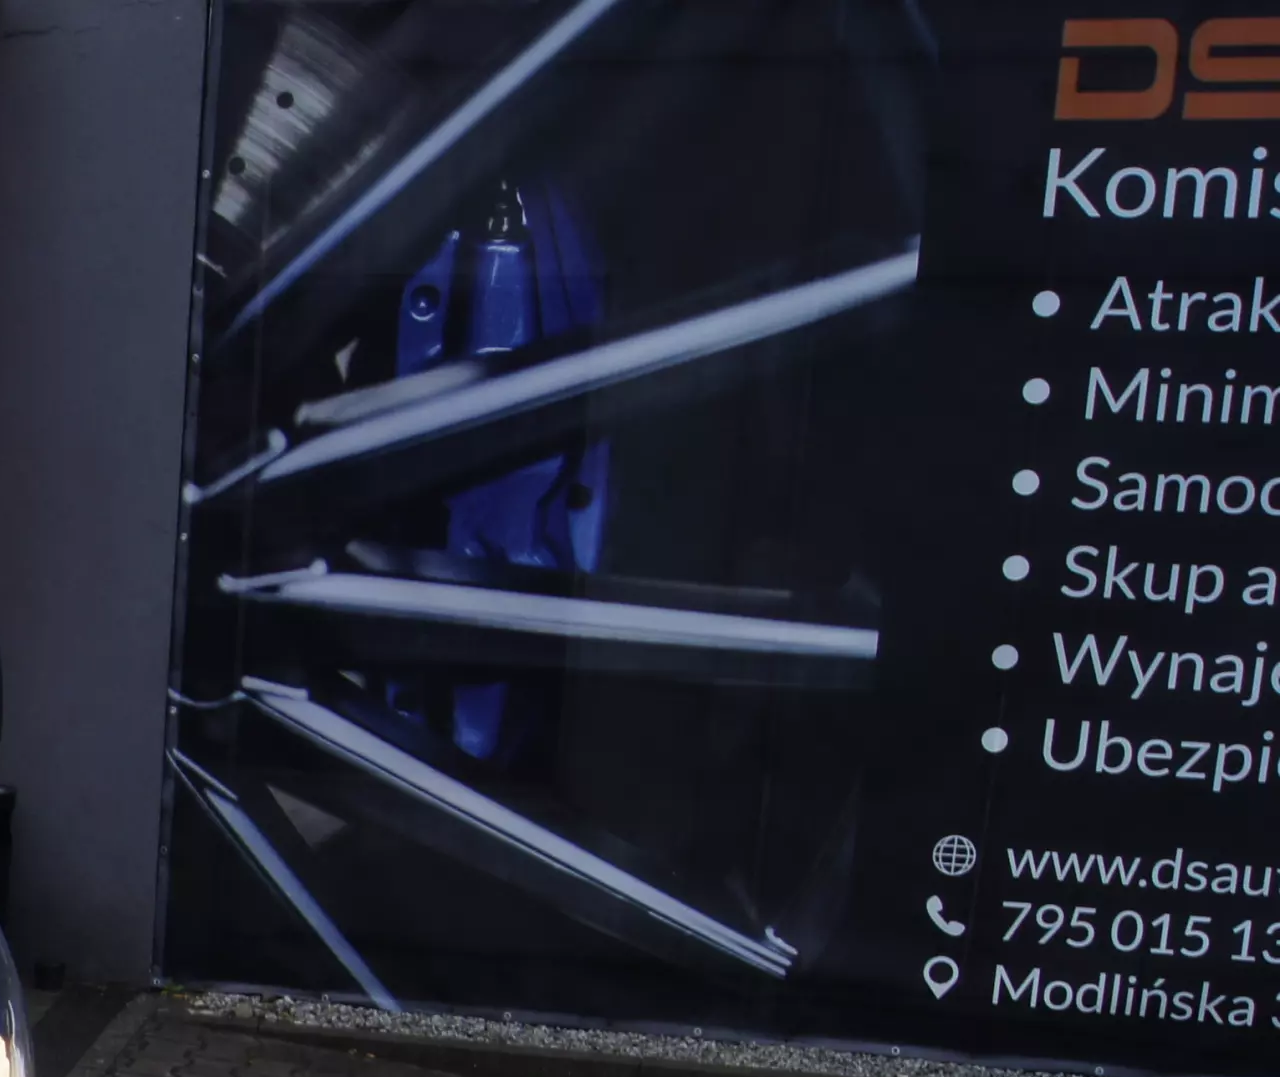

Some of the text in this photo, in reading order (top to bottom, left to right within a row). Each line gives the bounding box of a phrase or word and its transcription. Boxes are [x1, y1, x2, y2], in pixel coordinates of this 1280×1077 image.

[1060, 545, 1225, 614] Skup
[1042, 718, 1280, 793] Ubezpi
[1001, 901, 1097, 949] 795
[1110, 910, 1212, 958] 015
[991, 964, 1256, 1029] Modlińska
